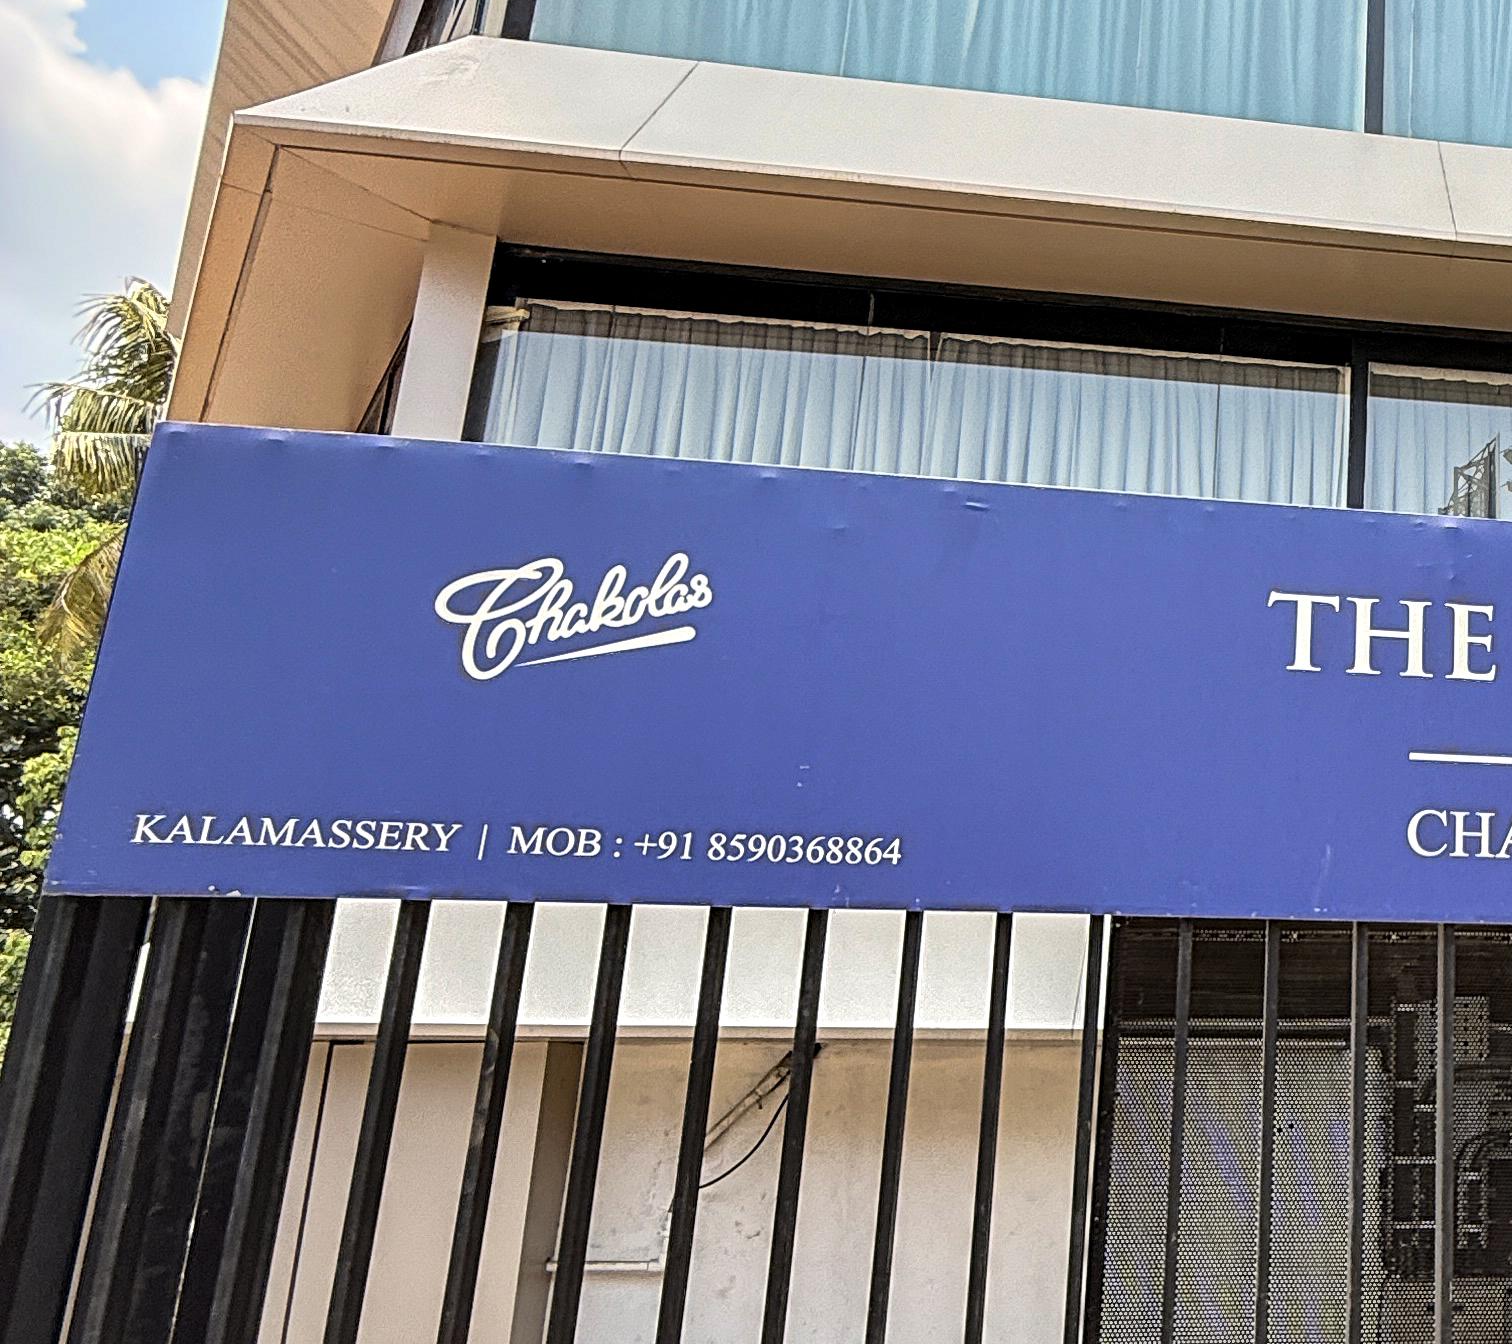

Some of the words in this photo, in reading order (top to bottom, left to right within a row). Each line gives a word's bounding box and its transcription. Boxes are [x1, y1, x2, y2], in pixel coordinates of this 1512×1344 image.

[434, 552, 713, 680] Chakolas
[1267, 590, 1496, 682] THE
[130, 814, 463, 852] KALAMASSERY
[507, 826, 602, 857] MOB
[634, 831, 692, 860] +91
[707, 832, 902, 865] 8590368864
